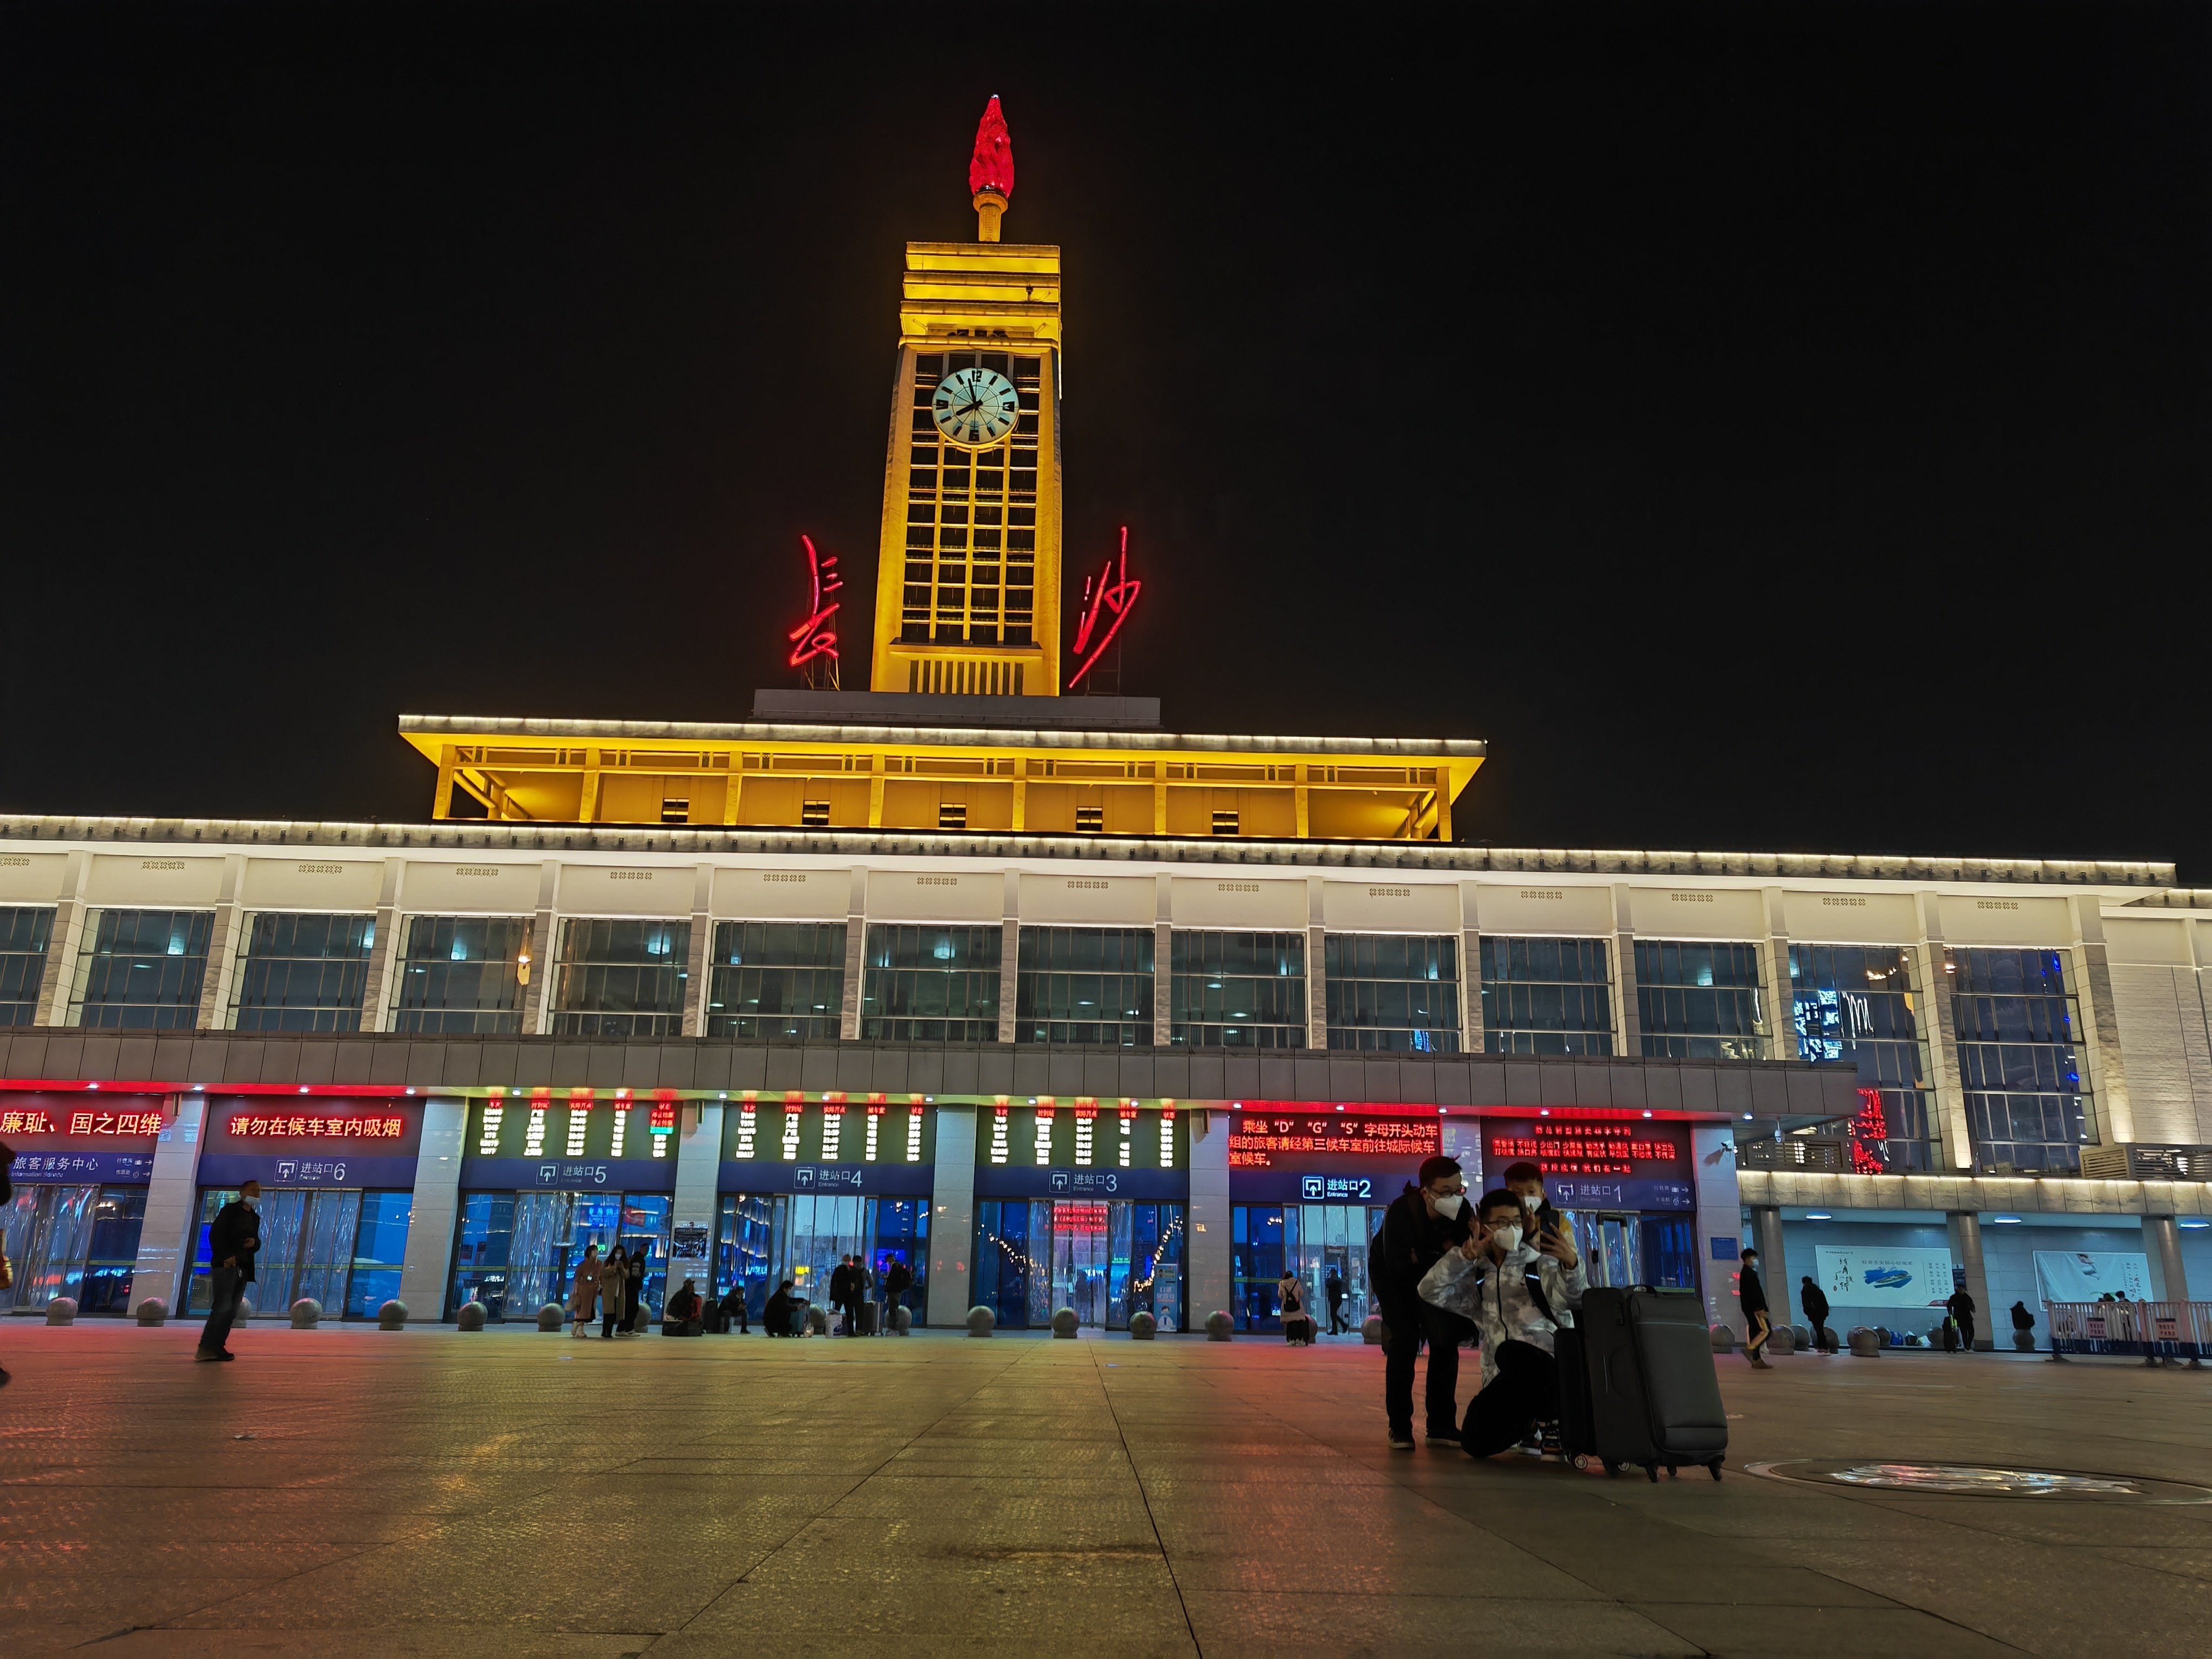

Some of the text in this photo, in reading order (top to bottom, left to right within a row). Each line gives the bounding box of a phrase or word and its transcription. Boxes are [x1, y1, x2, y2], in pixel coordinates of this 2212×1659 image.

[972, 370, 982, 382] 12
[231, 1116, 402, 1137] 请勿在候车室内吸烟
[1243, 1121, 1267, 1133] 乘坐
[1364, 1123, 1438, 1137] 字母开头动车
[1229, 1137, 1435, 1154] 组的旅客请经第三候车室前往城际候车
[12, 1157, 98, 1171] 旅客服务中心
